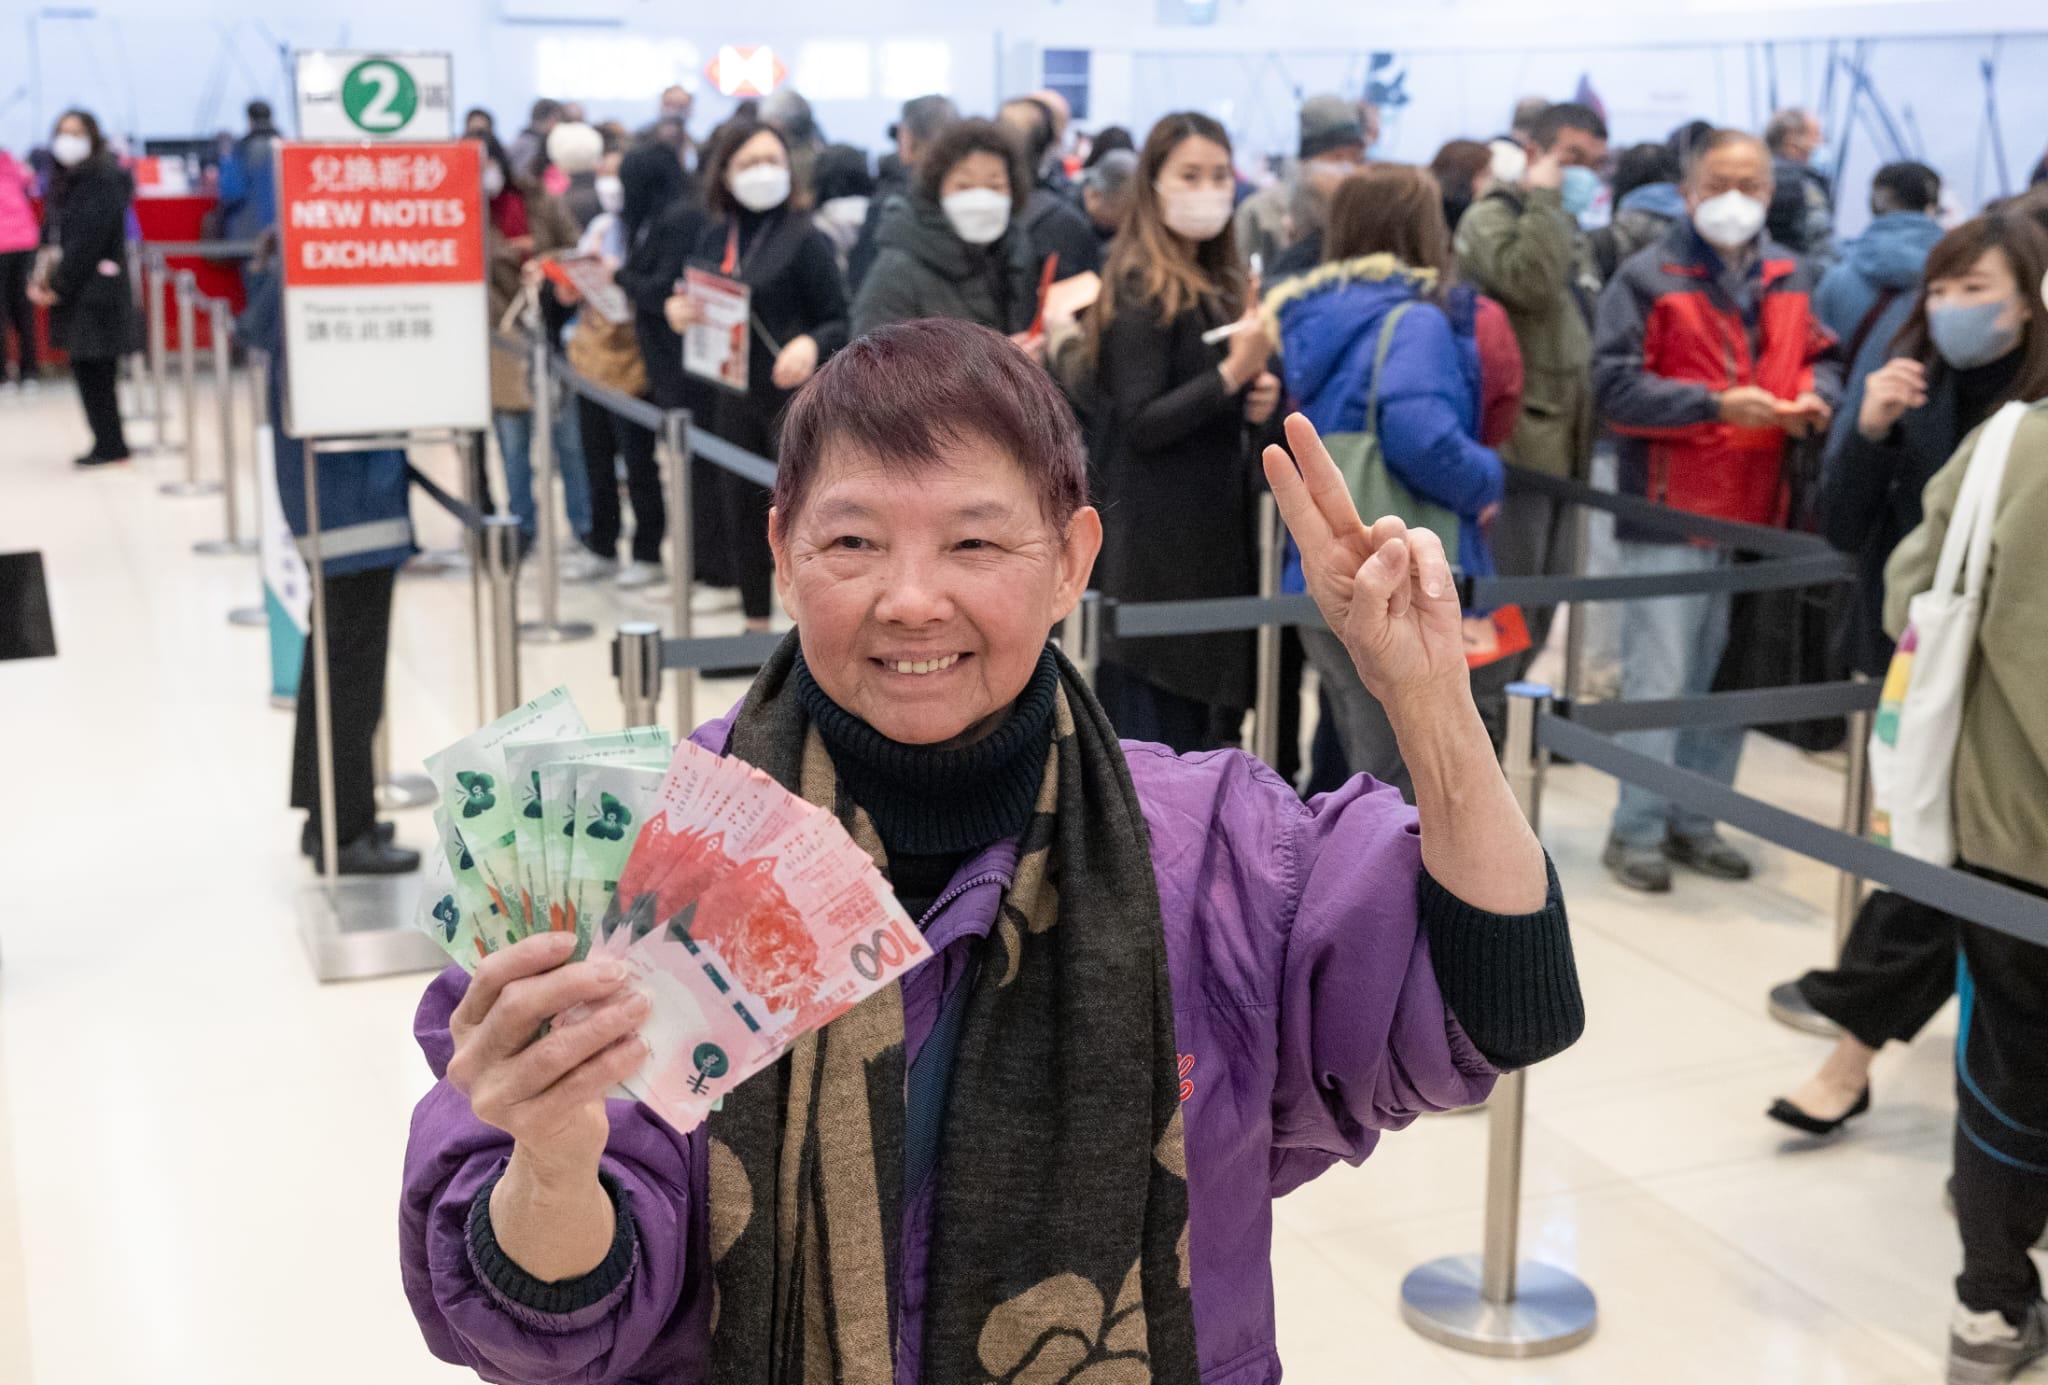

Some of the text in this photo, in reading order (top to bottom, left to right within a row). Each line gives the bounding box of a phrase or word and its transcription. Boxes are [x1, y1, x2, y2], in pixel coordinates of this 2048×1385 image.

[359, 64, 402, 127] 2
[292, 199, 466, 229] NEW NOTES
[302, 239, 458, 269] EXCHANGE
[850, 920, 921, 981] 100
